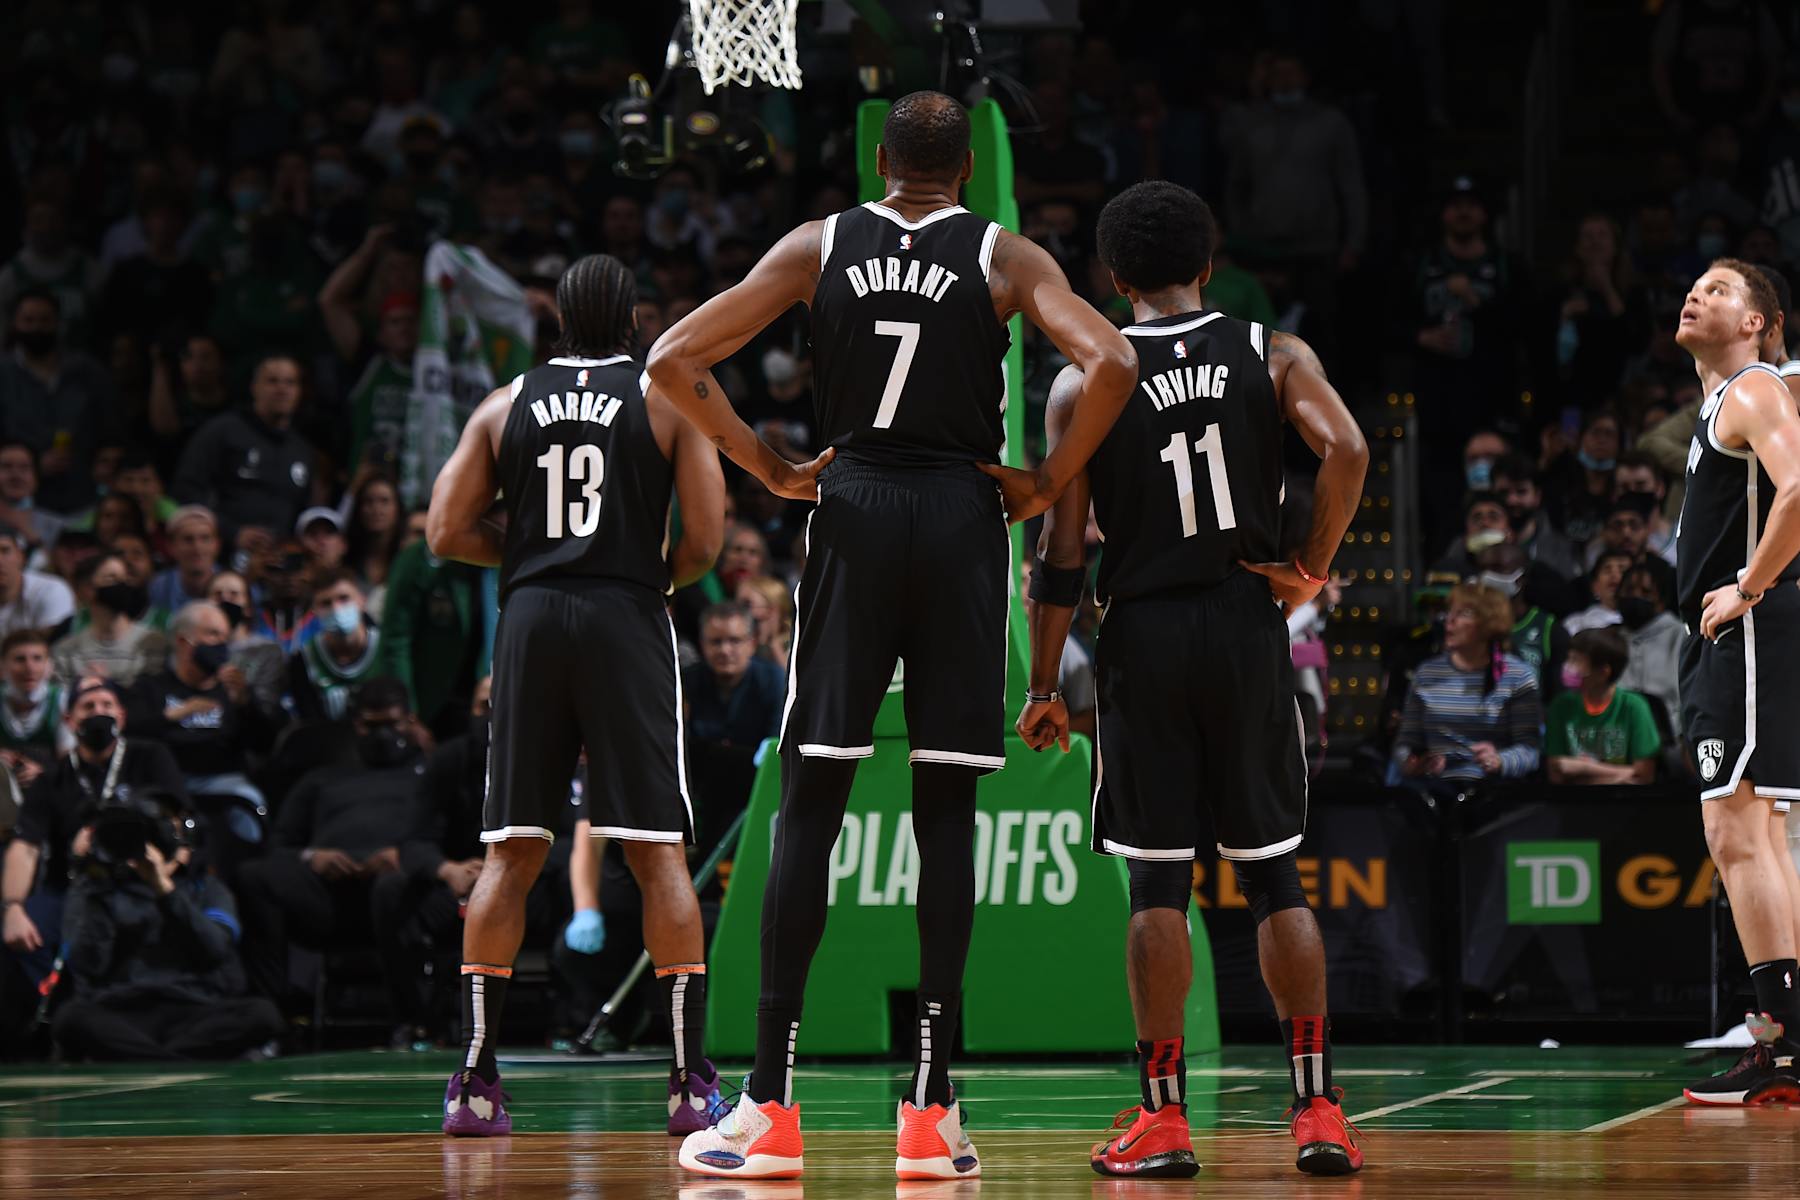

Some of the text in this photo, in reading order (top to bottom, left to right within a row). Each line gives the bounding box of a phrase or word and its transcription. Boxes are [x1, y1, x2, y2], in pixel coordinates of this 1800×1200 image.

[845, 256, 960, 303] DURANT
[530, 390, 624, 428] HARDEN
[872, 319, 921, 430] 7
[1140, 364, 1229, 412] IRVING
[537, 443, 605, 538] 13
[1159, 422, 1237, 539] 11
[827, 809, 1083, 906] PLAOFFS
[1514, 855, 1592, 908] TD
